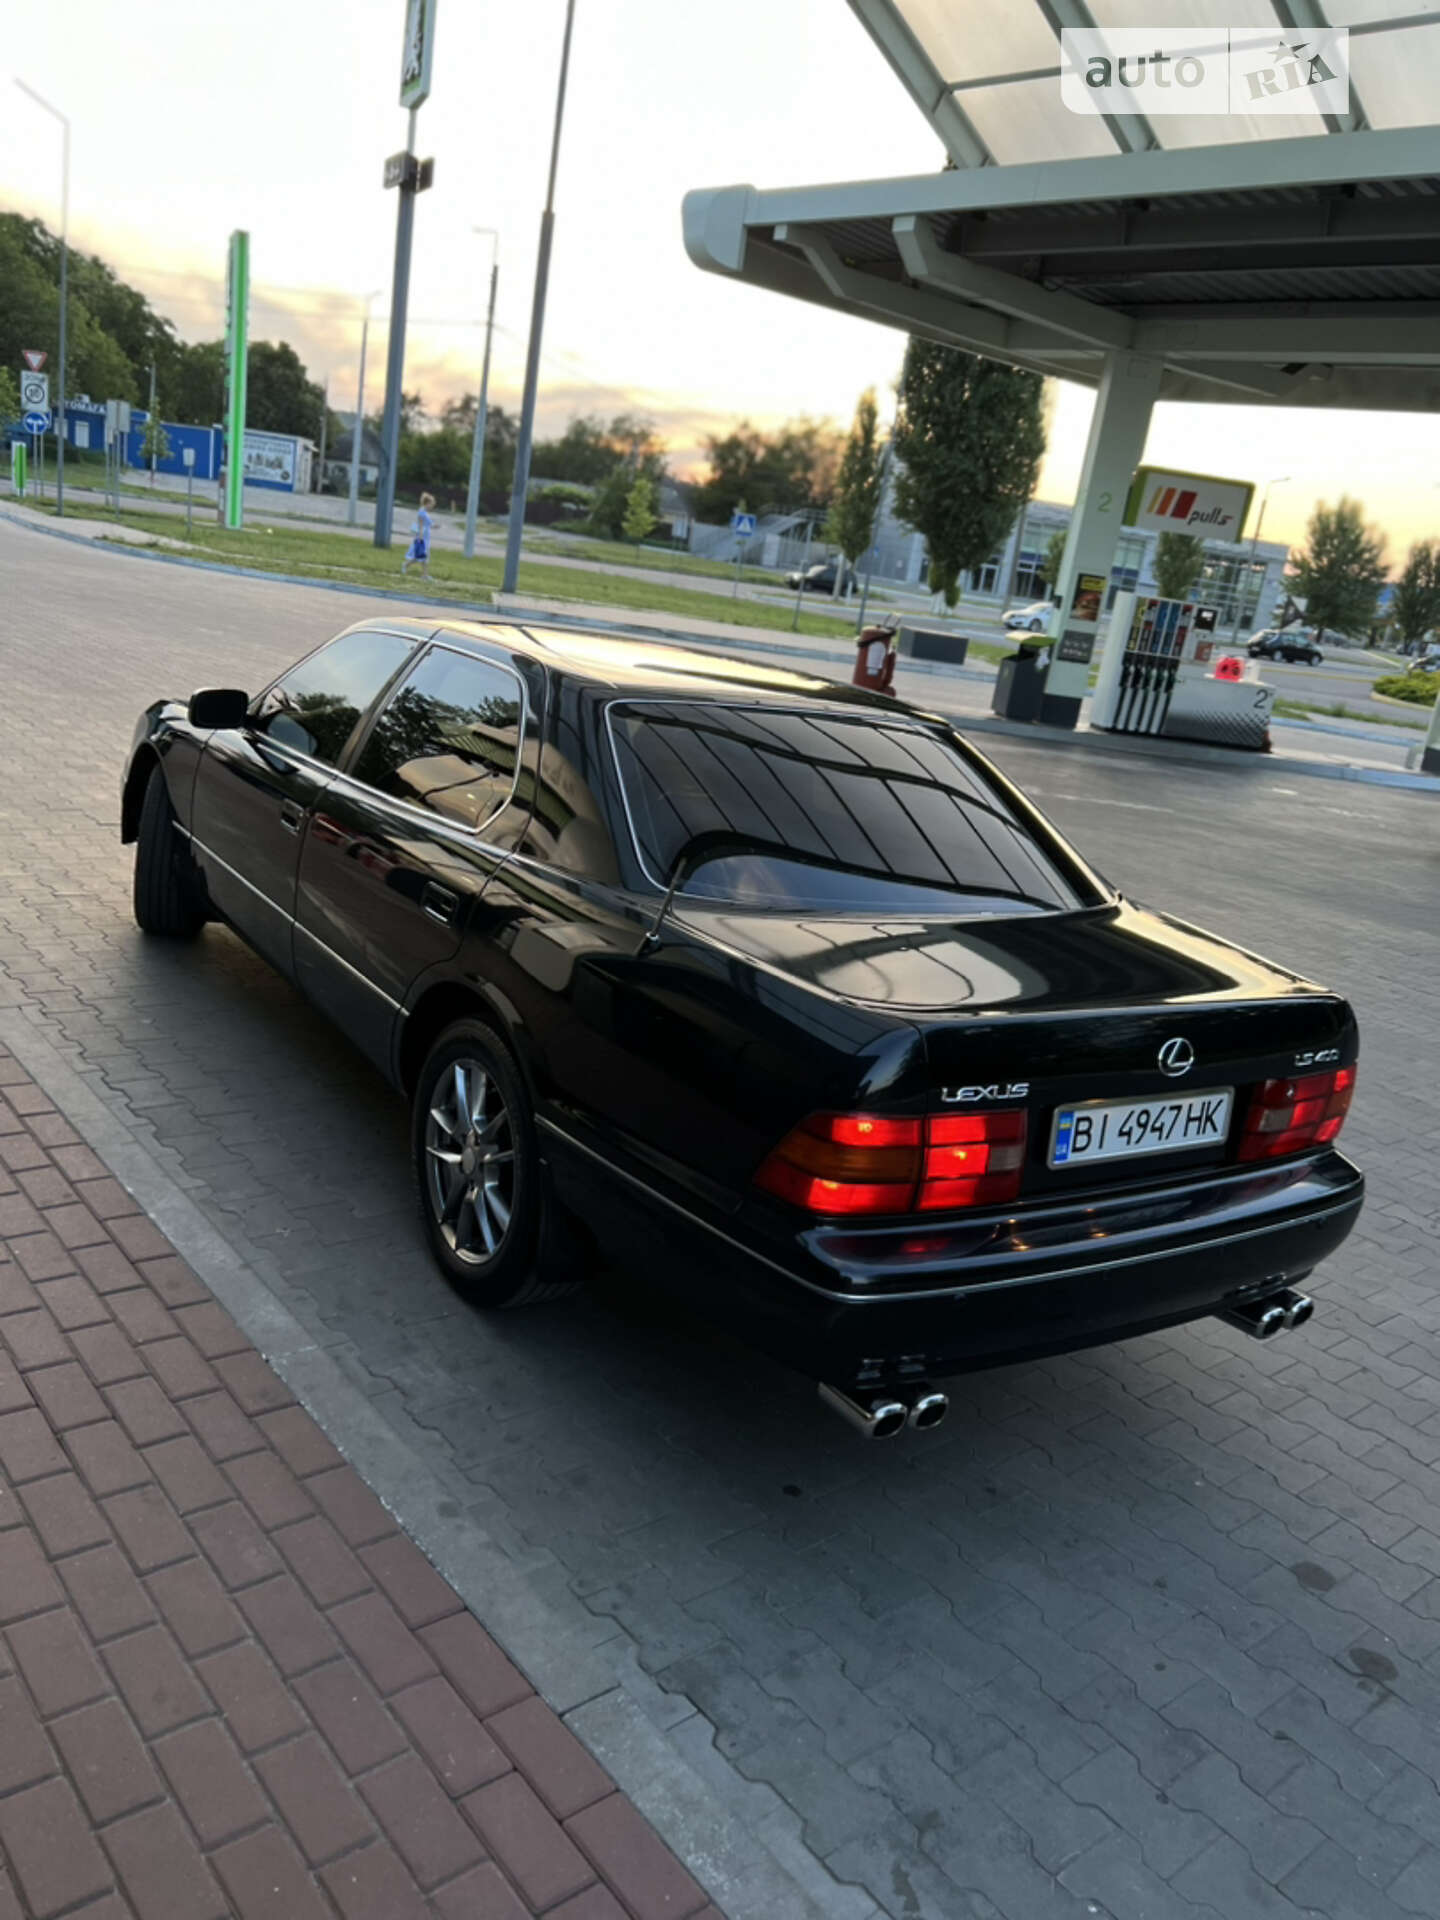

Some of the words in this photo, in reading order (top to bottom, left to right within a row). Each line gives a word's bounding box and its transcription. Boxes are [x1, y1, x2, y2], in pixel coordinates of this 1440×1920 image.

[1098, 492, 1113, 513] 2
[1187, 507, 1233, 526] pulls
[1253, 689, 1269, 709] 2
[942, 1083, 1030, 1102] LEXUS
[1072, 1113, 1108, 1153] BI
[1118, 1104, 1183, 1145] 4947
[1183, 1099, 1224, 1137] HK
